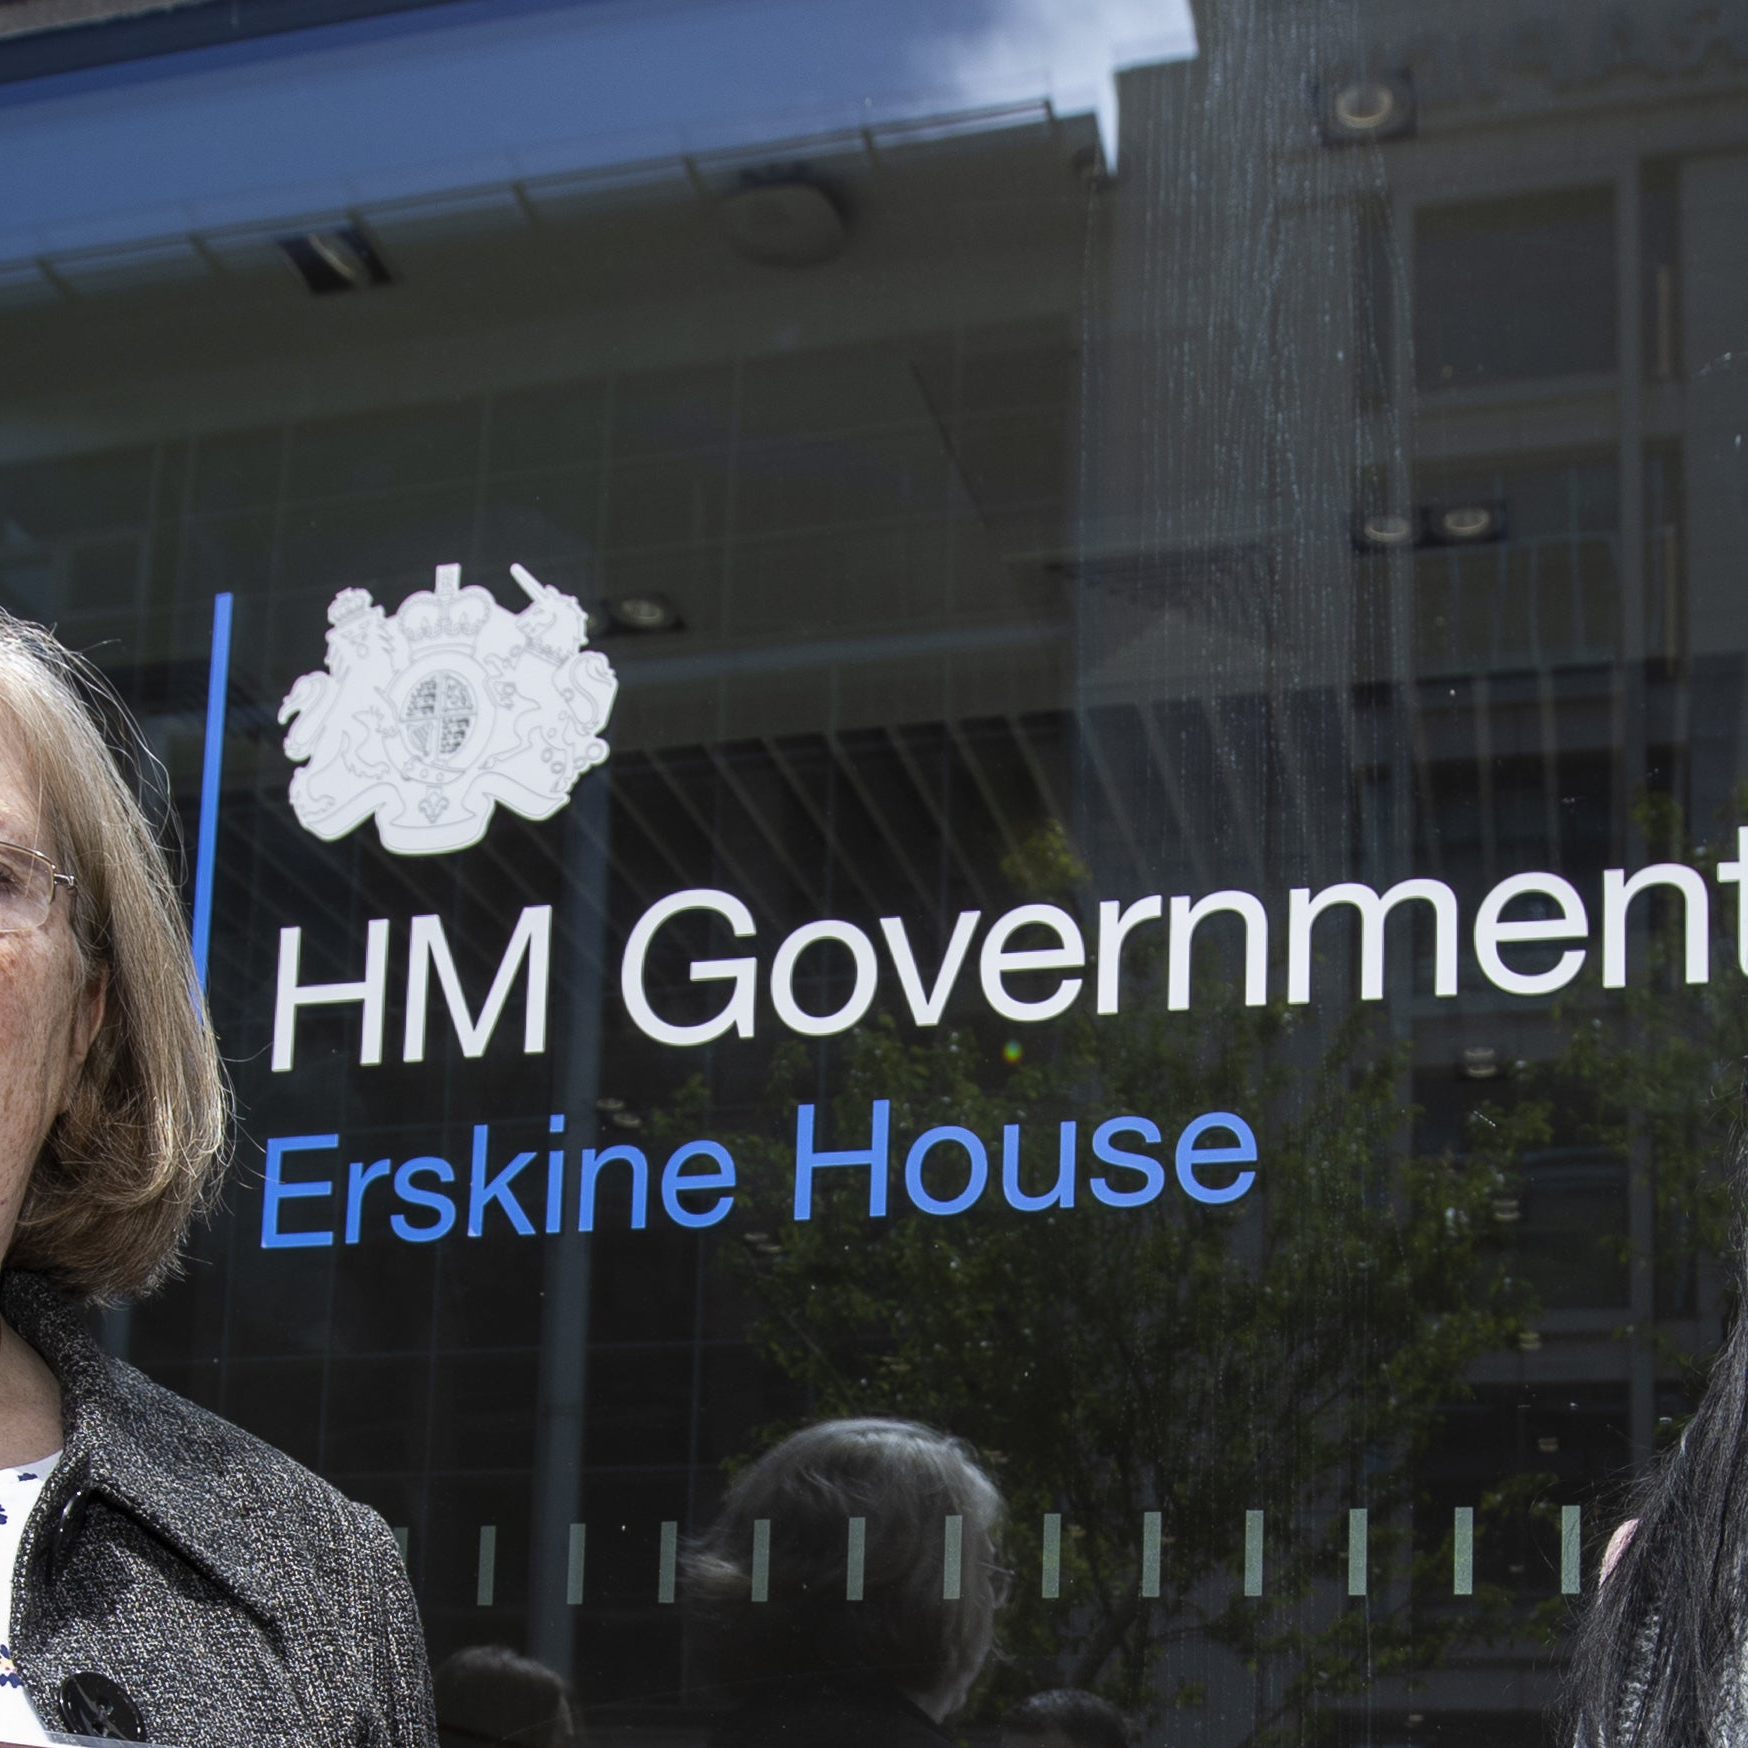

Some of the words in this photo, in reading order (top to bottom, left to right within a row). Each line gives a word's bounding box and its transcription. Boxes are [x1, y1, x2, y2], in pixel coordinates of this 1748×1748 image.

[271, 904, 552, 1072] HM
[260, 1114, 736, 1249] Erskine
[793, 1099, 1258, 1221] House
